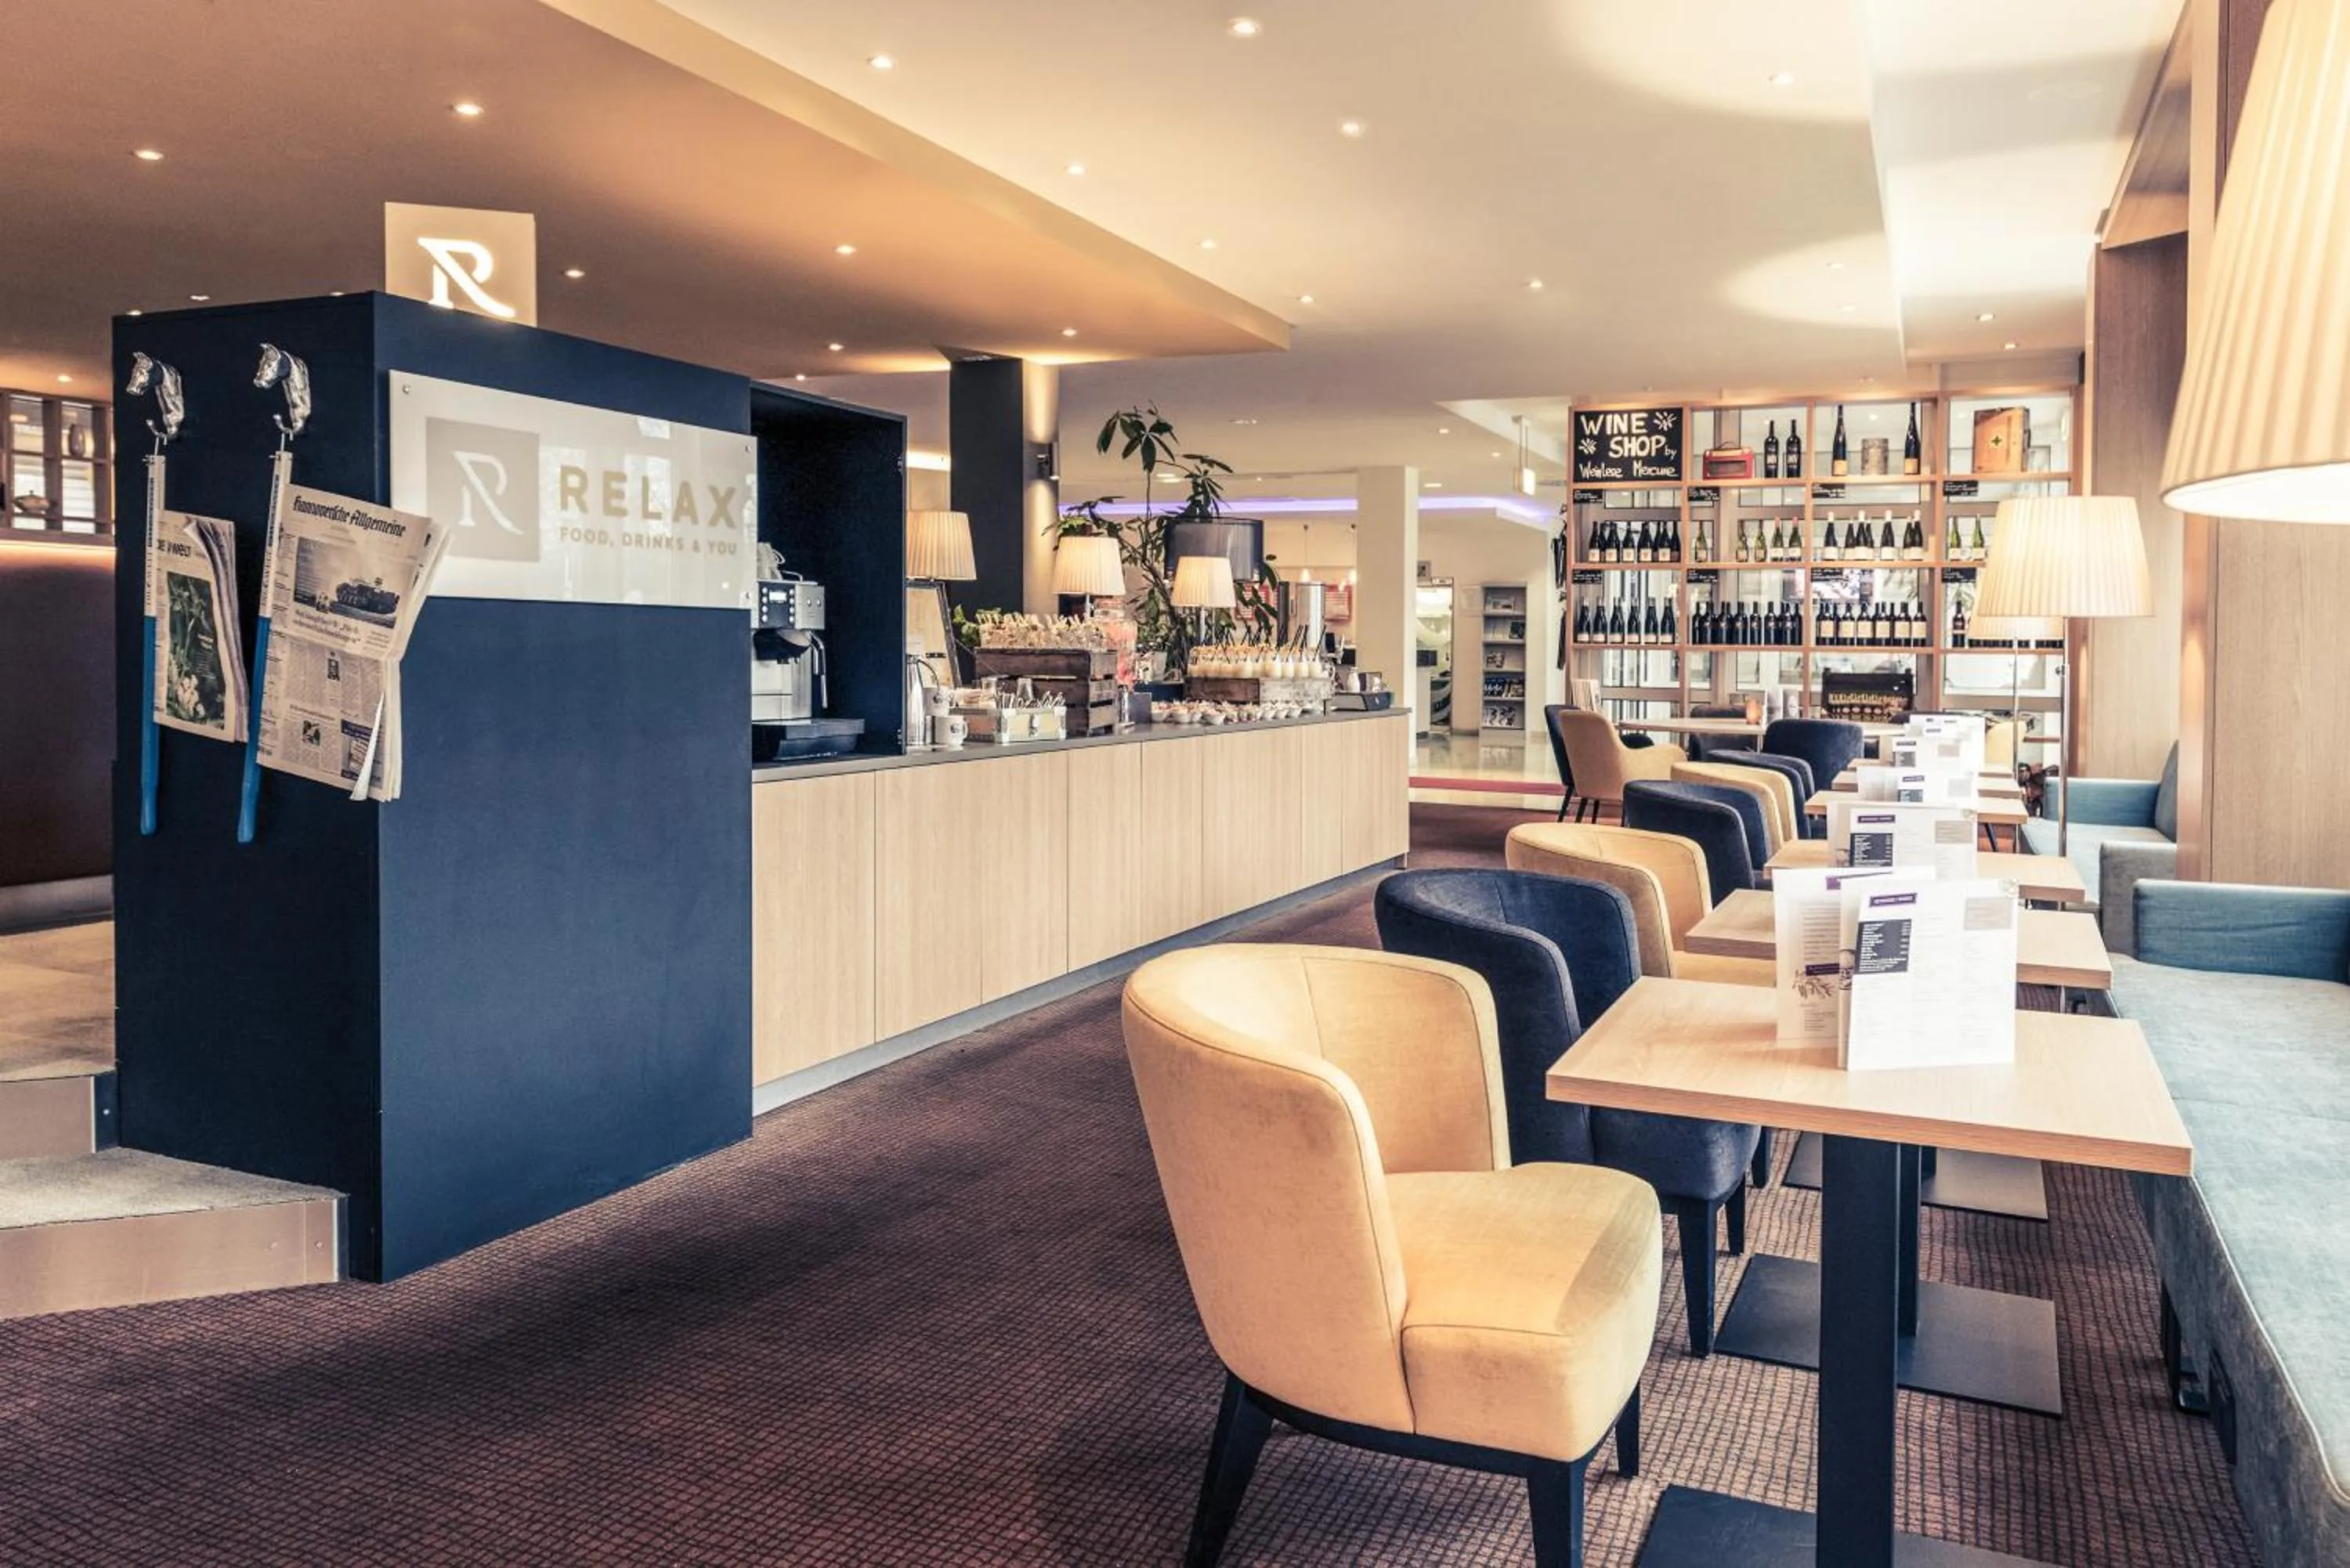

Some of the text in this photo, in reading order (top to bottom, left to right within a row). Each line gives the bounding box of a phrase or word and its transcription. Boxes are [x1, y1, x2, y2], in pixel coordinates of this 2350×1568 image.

[417, 237, 516, 318] R
[1580, 412, 1648, 435] WINE
[1607, 435, 1677, 461] SHOP by
[1632, 459, 1679, 478] Mercure
[560, 464, 737, 530] RELAX
[349, 508, 407, 537] Allgemeine
[560, 526, 737, 556] FOOD, DRINKS & YOU
